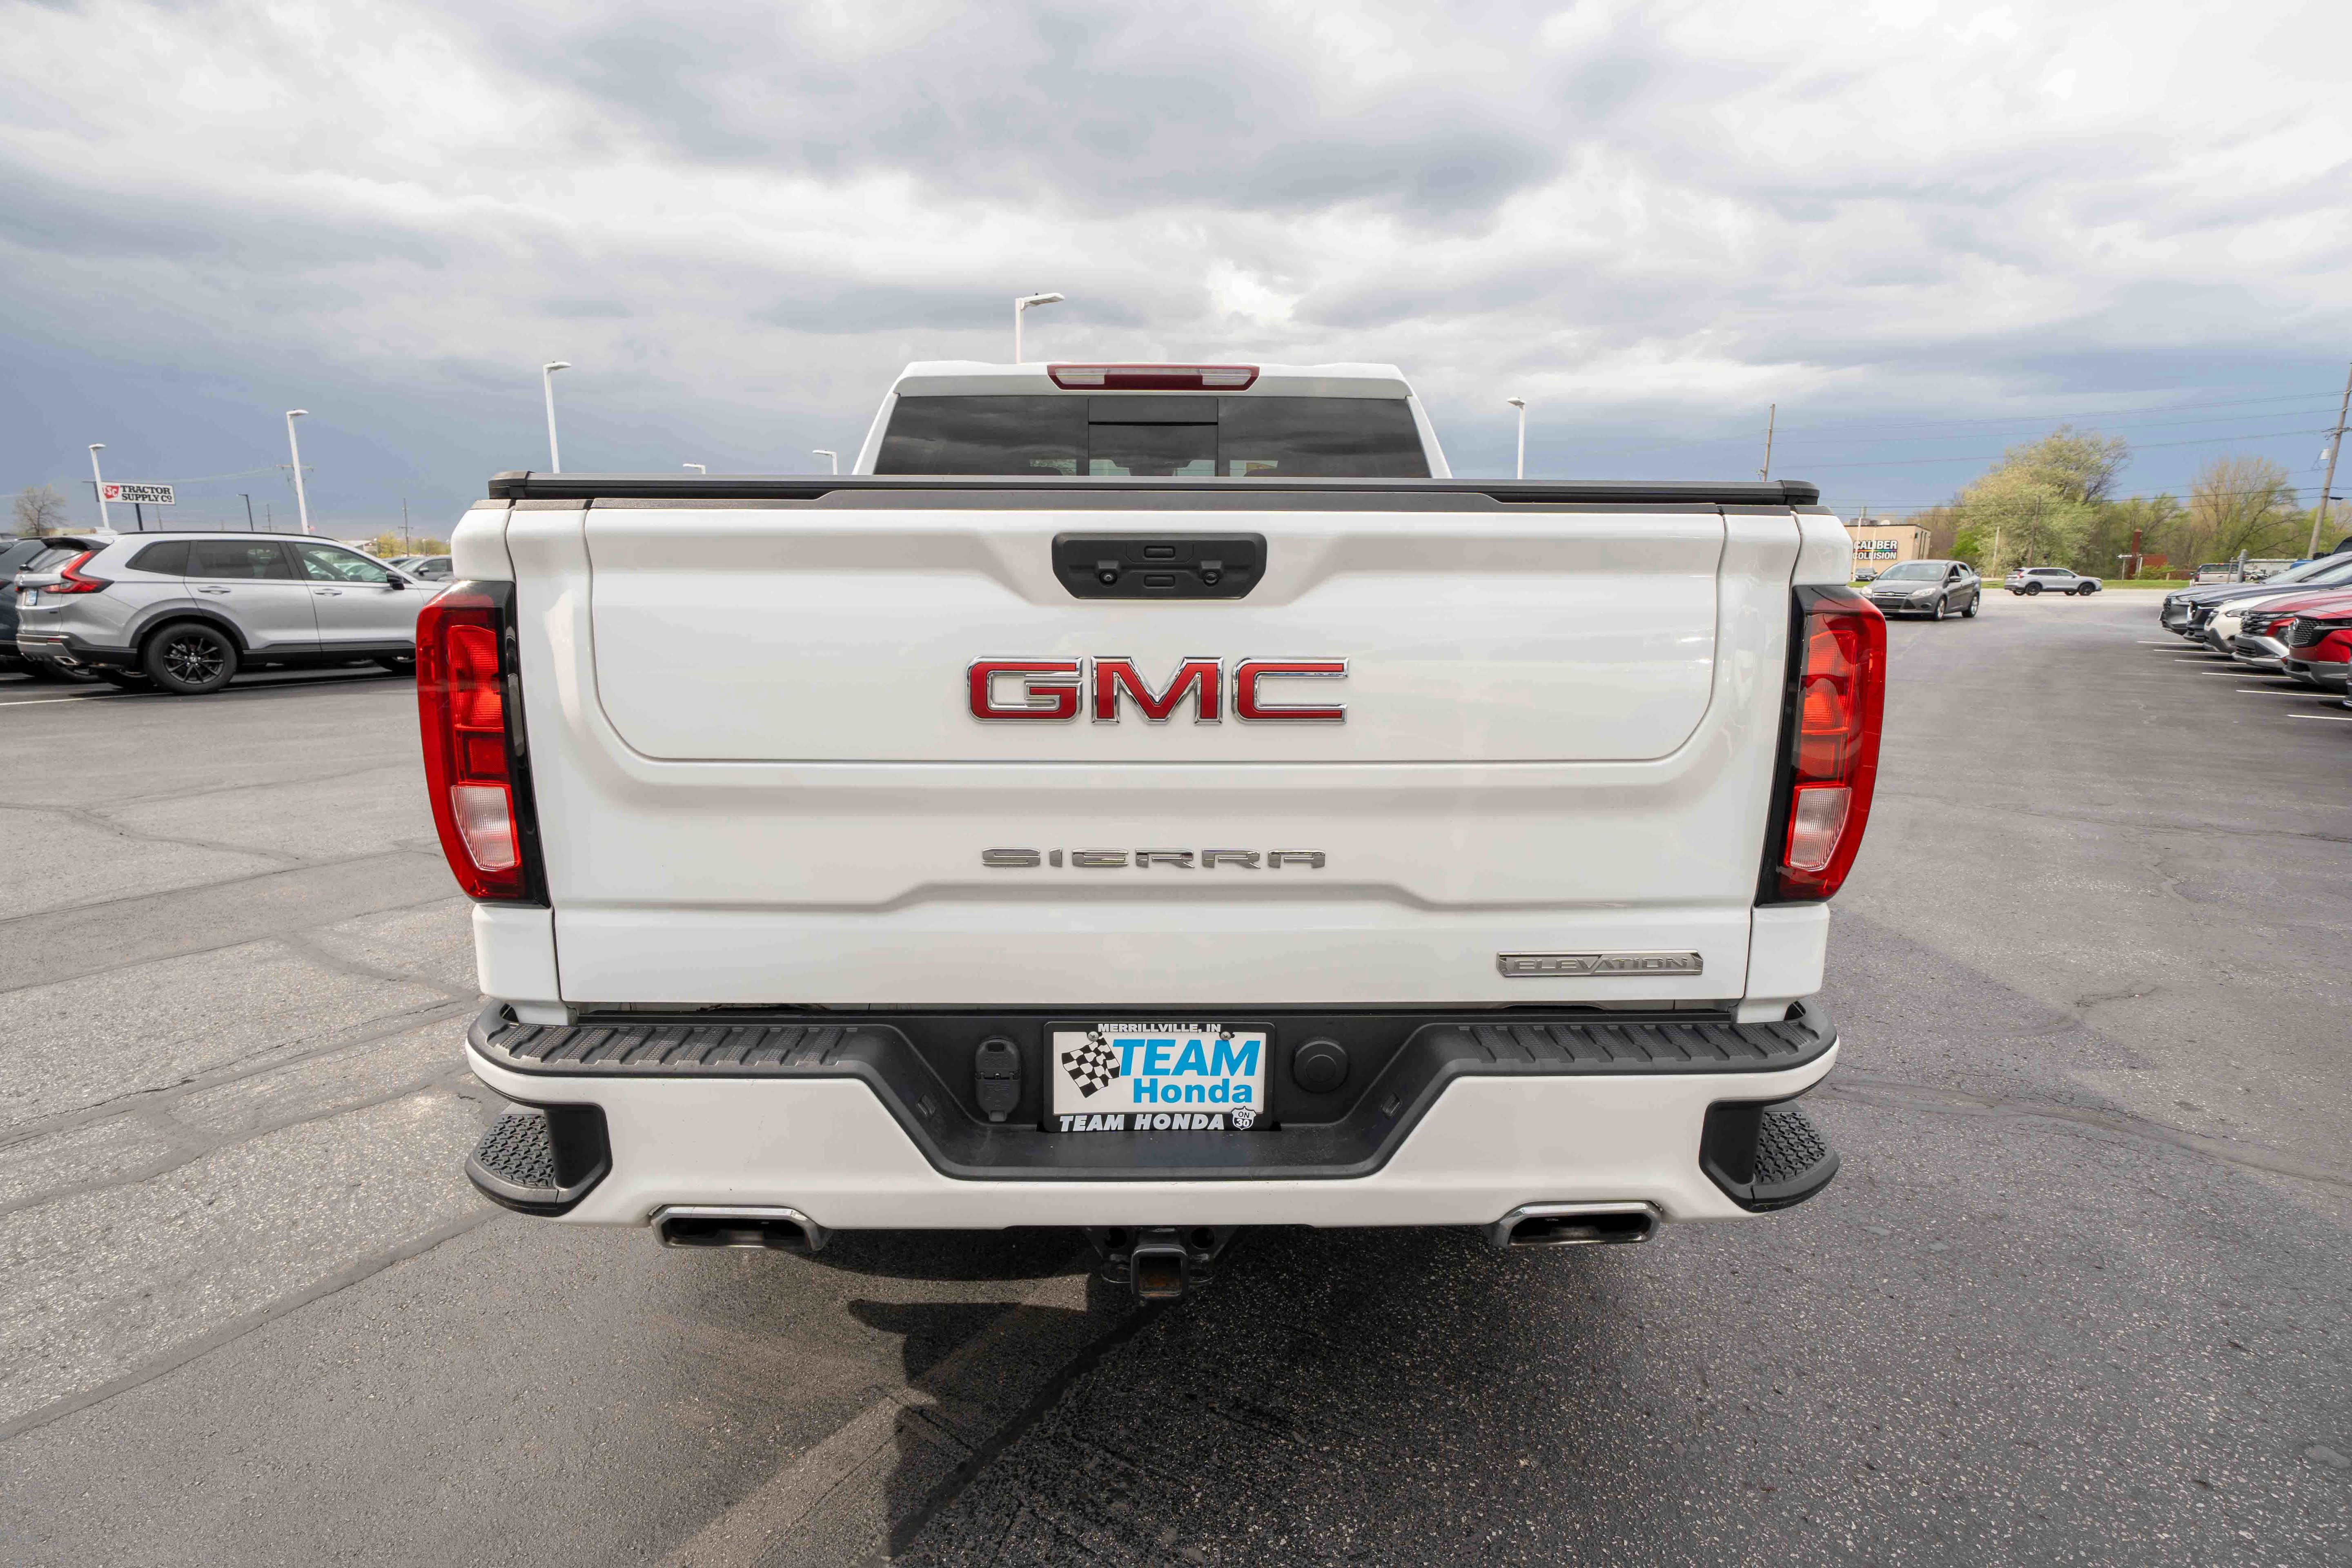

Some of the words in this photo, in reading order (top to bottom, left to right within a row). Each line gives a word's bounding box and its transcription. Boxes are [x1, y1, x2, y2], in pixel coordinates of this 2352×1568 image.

[120, 485, 171, 494] TRACTOR
[121, 494, 159, 502] SUPPLY
[1854, 540, 1898, 550] CALIBER
[967, 656, 1349, 724] GMC
[982, 848, 1326, 869] SIERRA
[1514, 957, 1689, 971] ELEVATION
[1098, 1024, 1202, 1033] MERRILLVILLE,
[1207, 1024, 1221, 1032] IN
[1112, 1039, 1261, 1076] TEAM
[1133, 1078, 1252, 1103] Honda
[1060, 1114, 1124, 1131] TEAM
[1134, 1114, 1224, 1130] HONDA
[1236, 1118, 1250, 1127] 30
